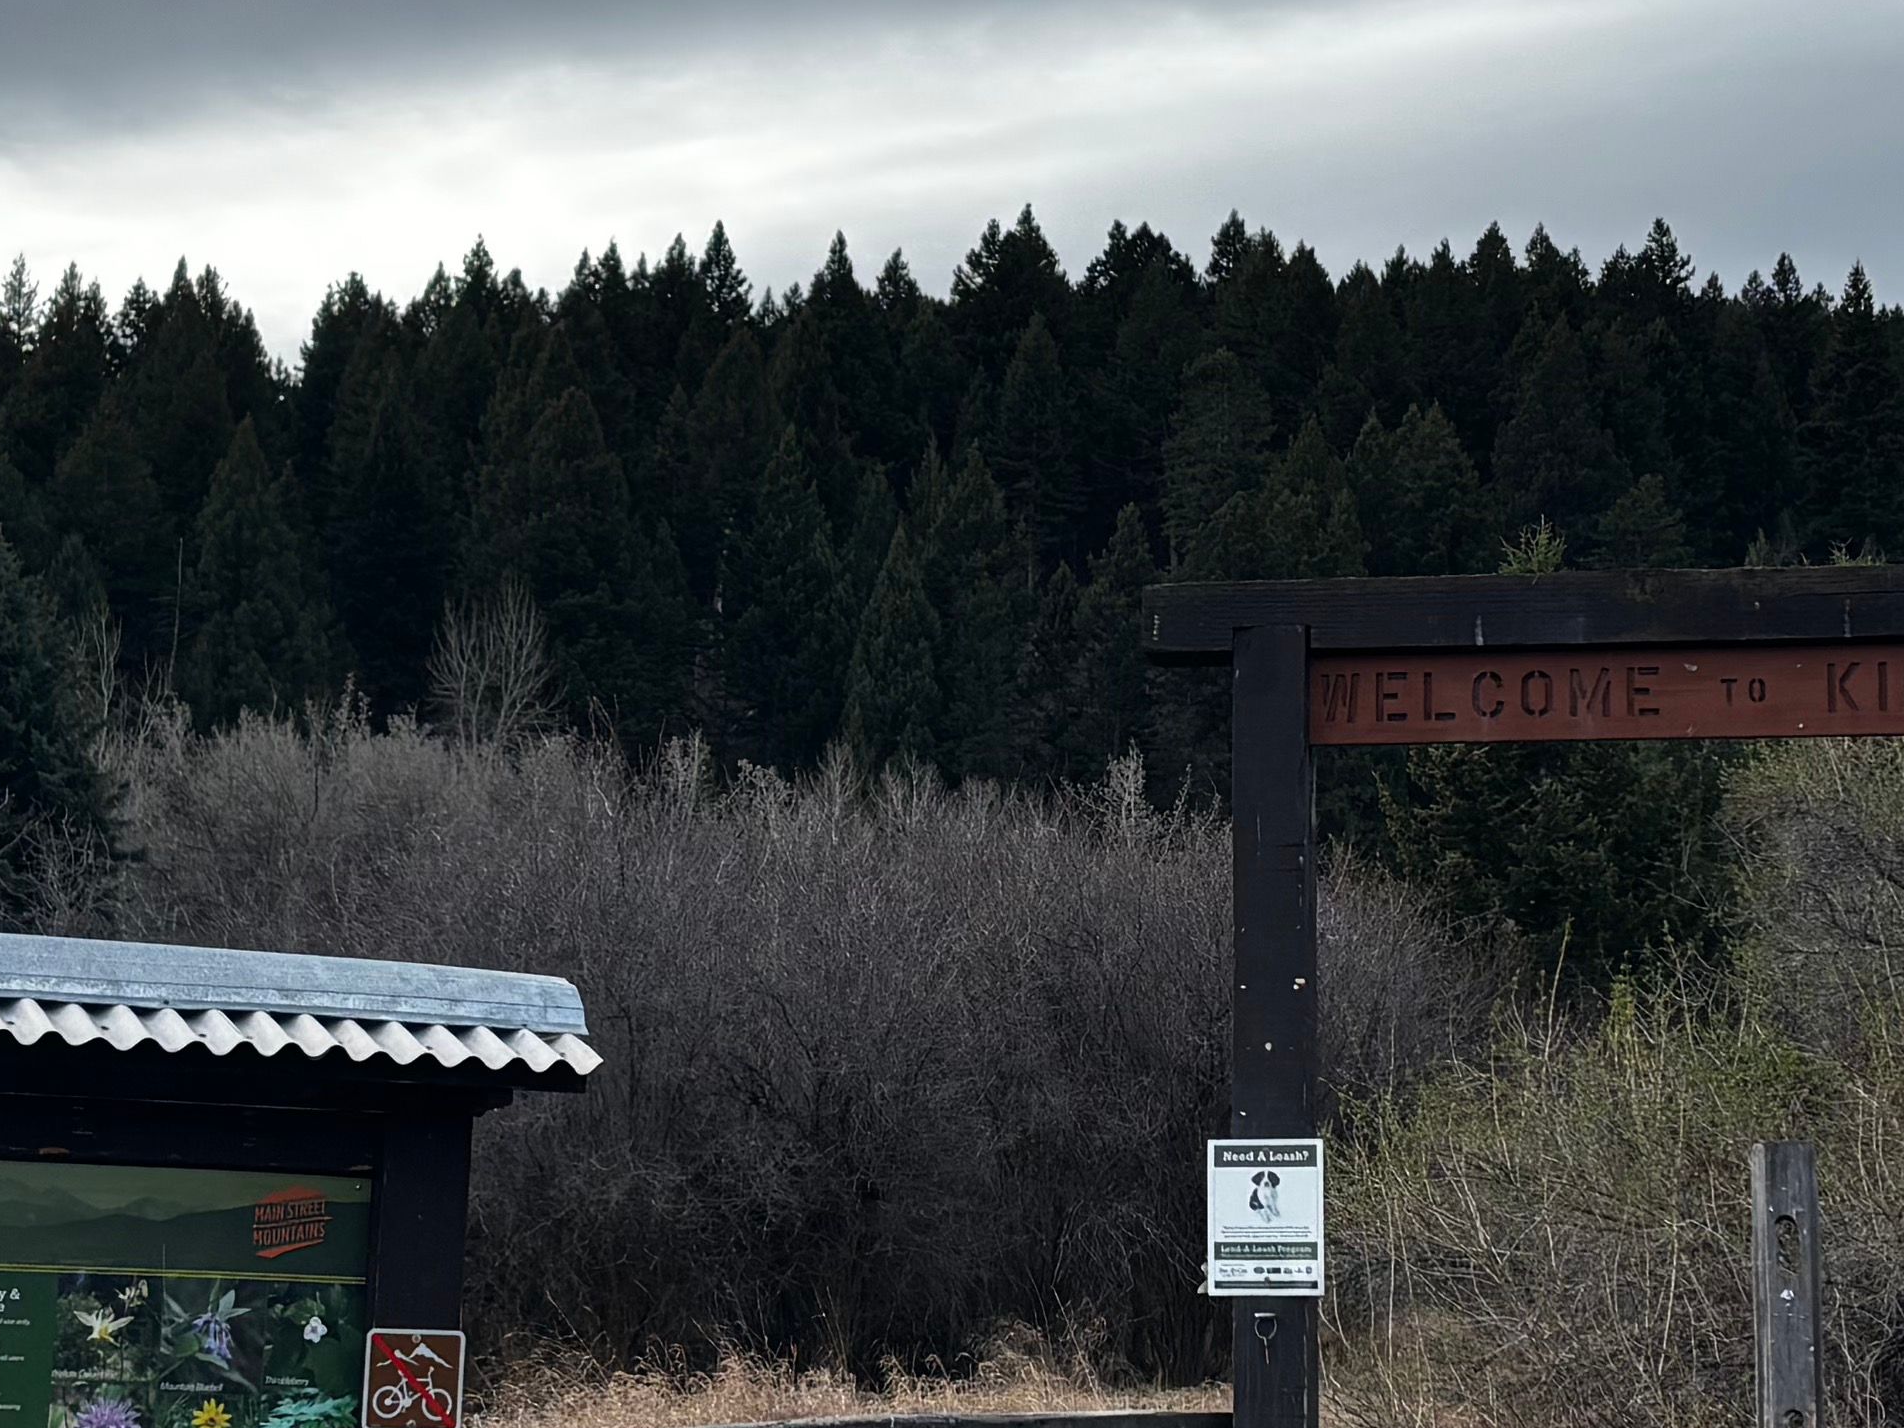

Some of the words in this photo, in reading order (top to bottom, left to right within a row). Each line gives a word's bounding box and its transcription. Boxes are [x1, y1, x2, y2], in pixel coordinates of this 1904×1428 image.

[1321, 665, 1661, 722] WELCOME
[1720, 677, 1767, 705] TO
[1223, 1151, 1254, 1162] Need
[1258, 1151, 1266, 1161] A
[1270, 1150, 1309, 1161] Leash?
[255, 1205, 284, 1222] MAIN
[286, 1199, 325, 1218] STREET
[253, 1222, 326, 1246] MOUNTAINS
[1277, 1245, 1312, 1254] Program
[10, 1288, 20, 1300] &
